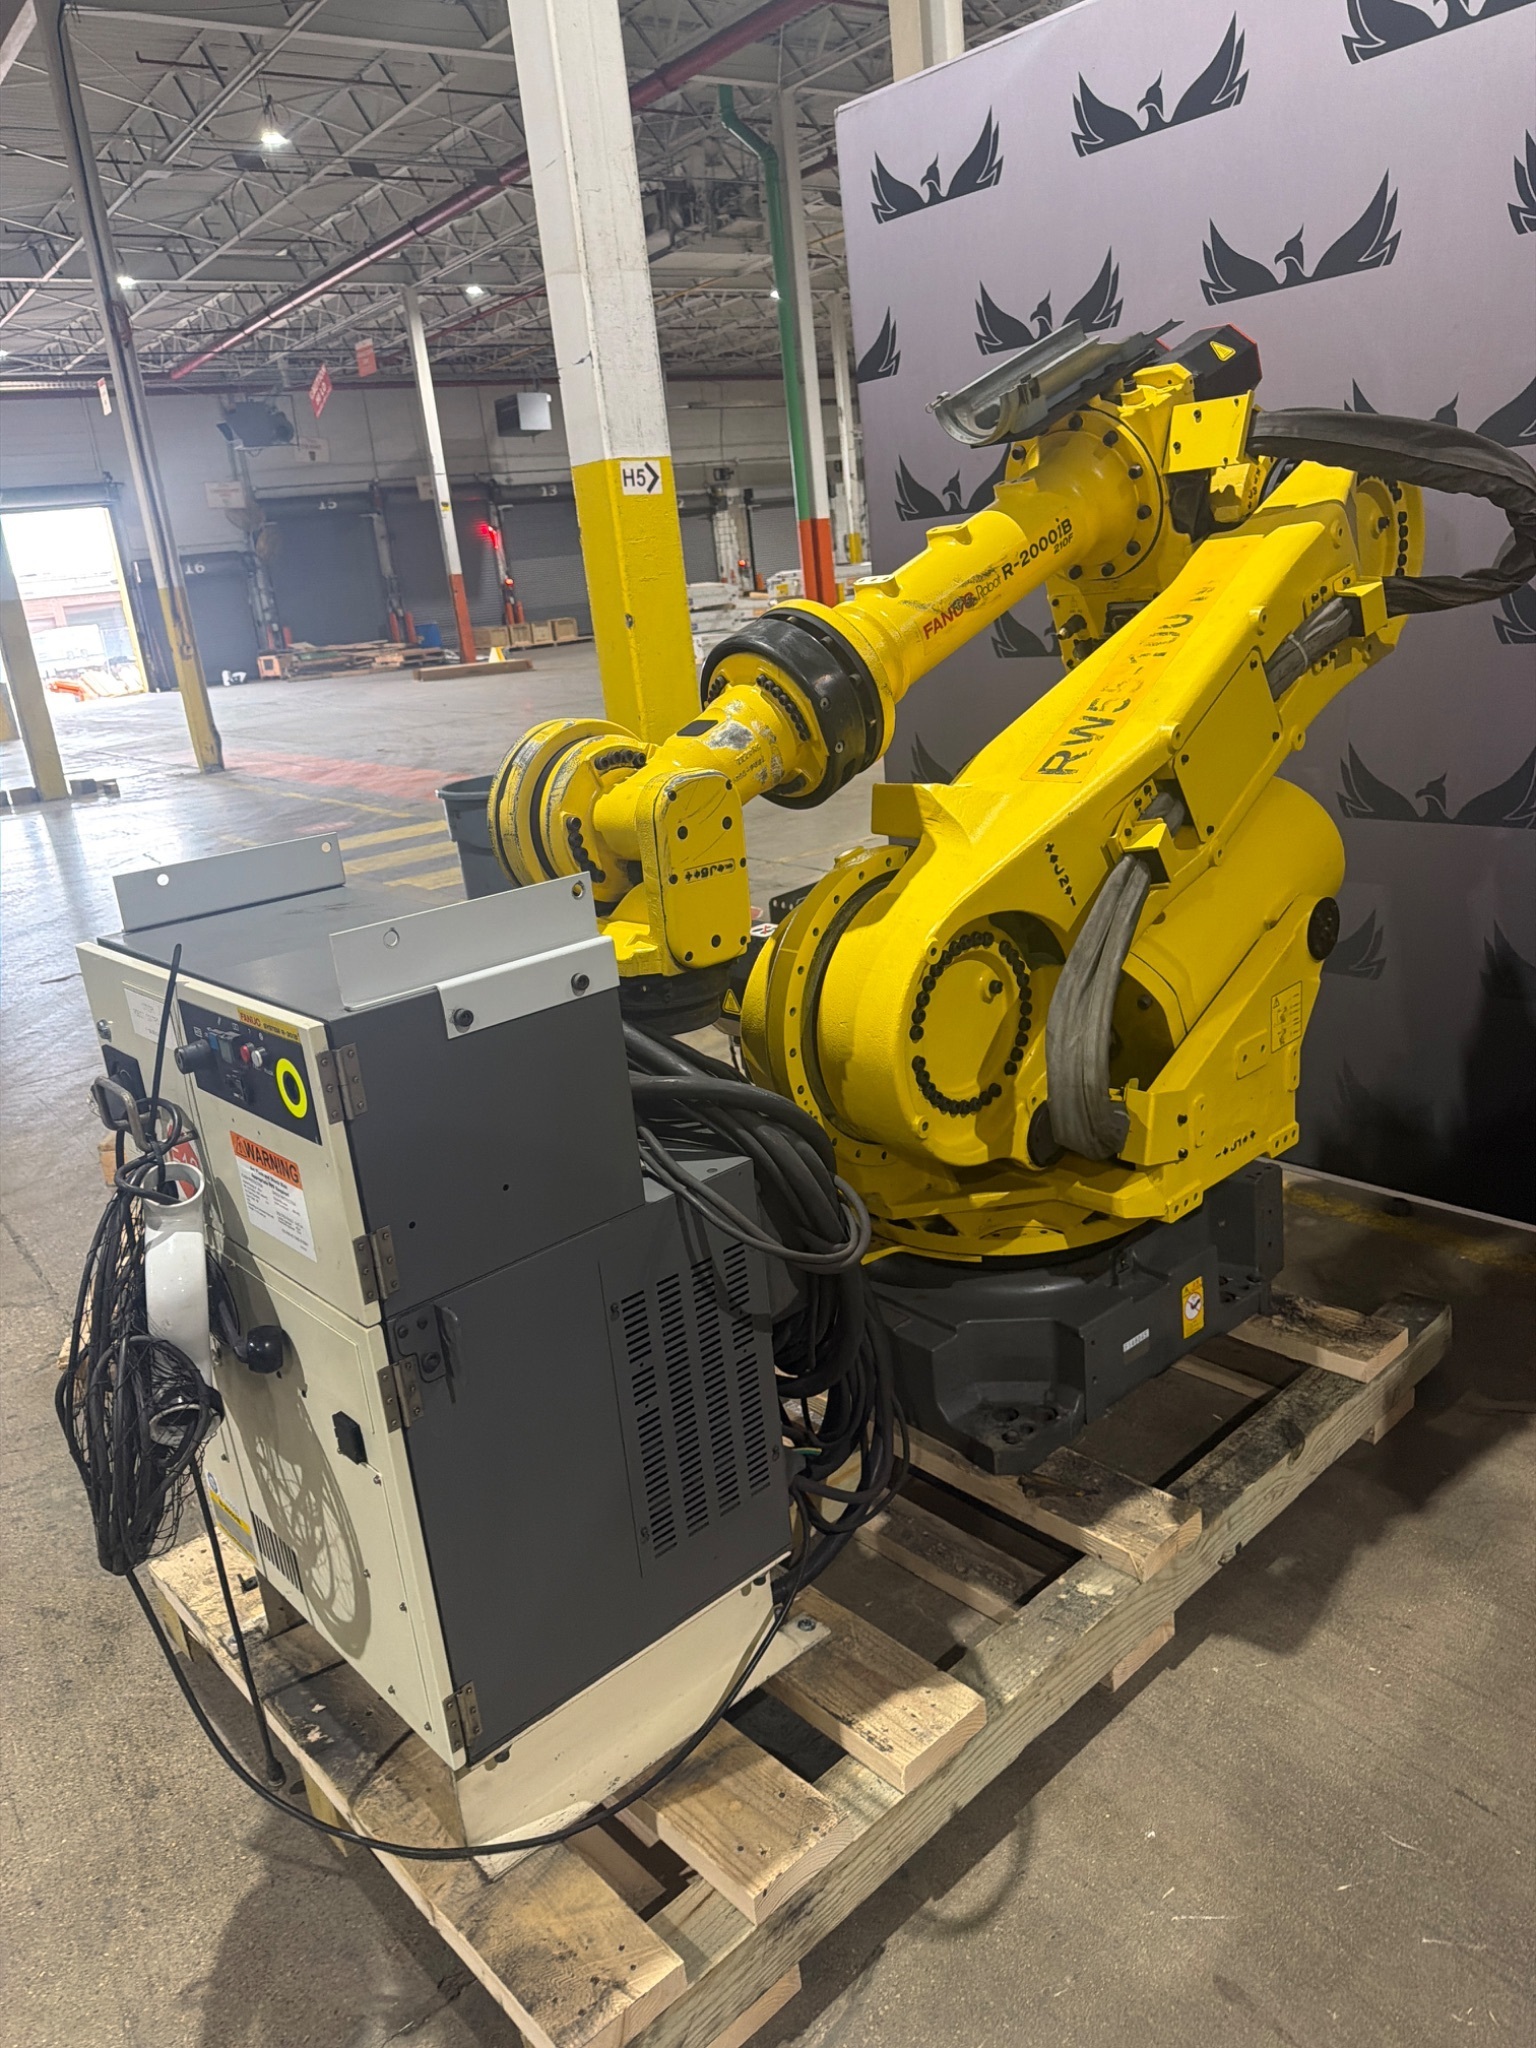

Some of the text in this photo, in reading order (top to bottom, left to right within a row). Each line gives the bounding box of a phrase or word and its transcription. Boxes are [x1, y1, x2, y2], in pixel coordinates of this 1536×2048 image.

[622, 468, 646, 487] H5
[541, 485, 558, 497] 13
[1001, 517, 1073, 581] R-2000iB
[1053, 532, 1074, 555] 210F
[239, 1013, 262, 1027] FANUC
[243, 1140, 300, 1184] WARNING
